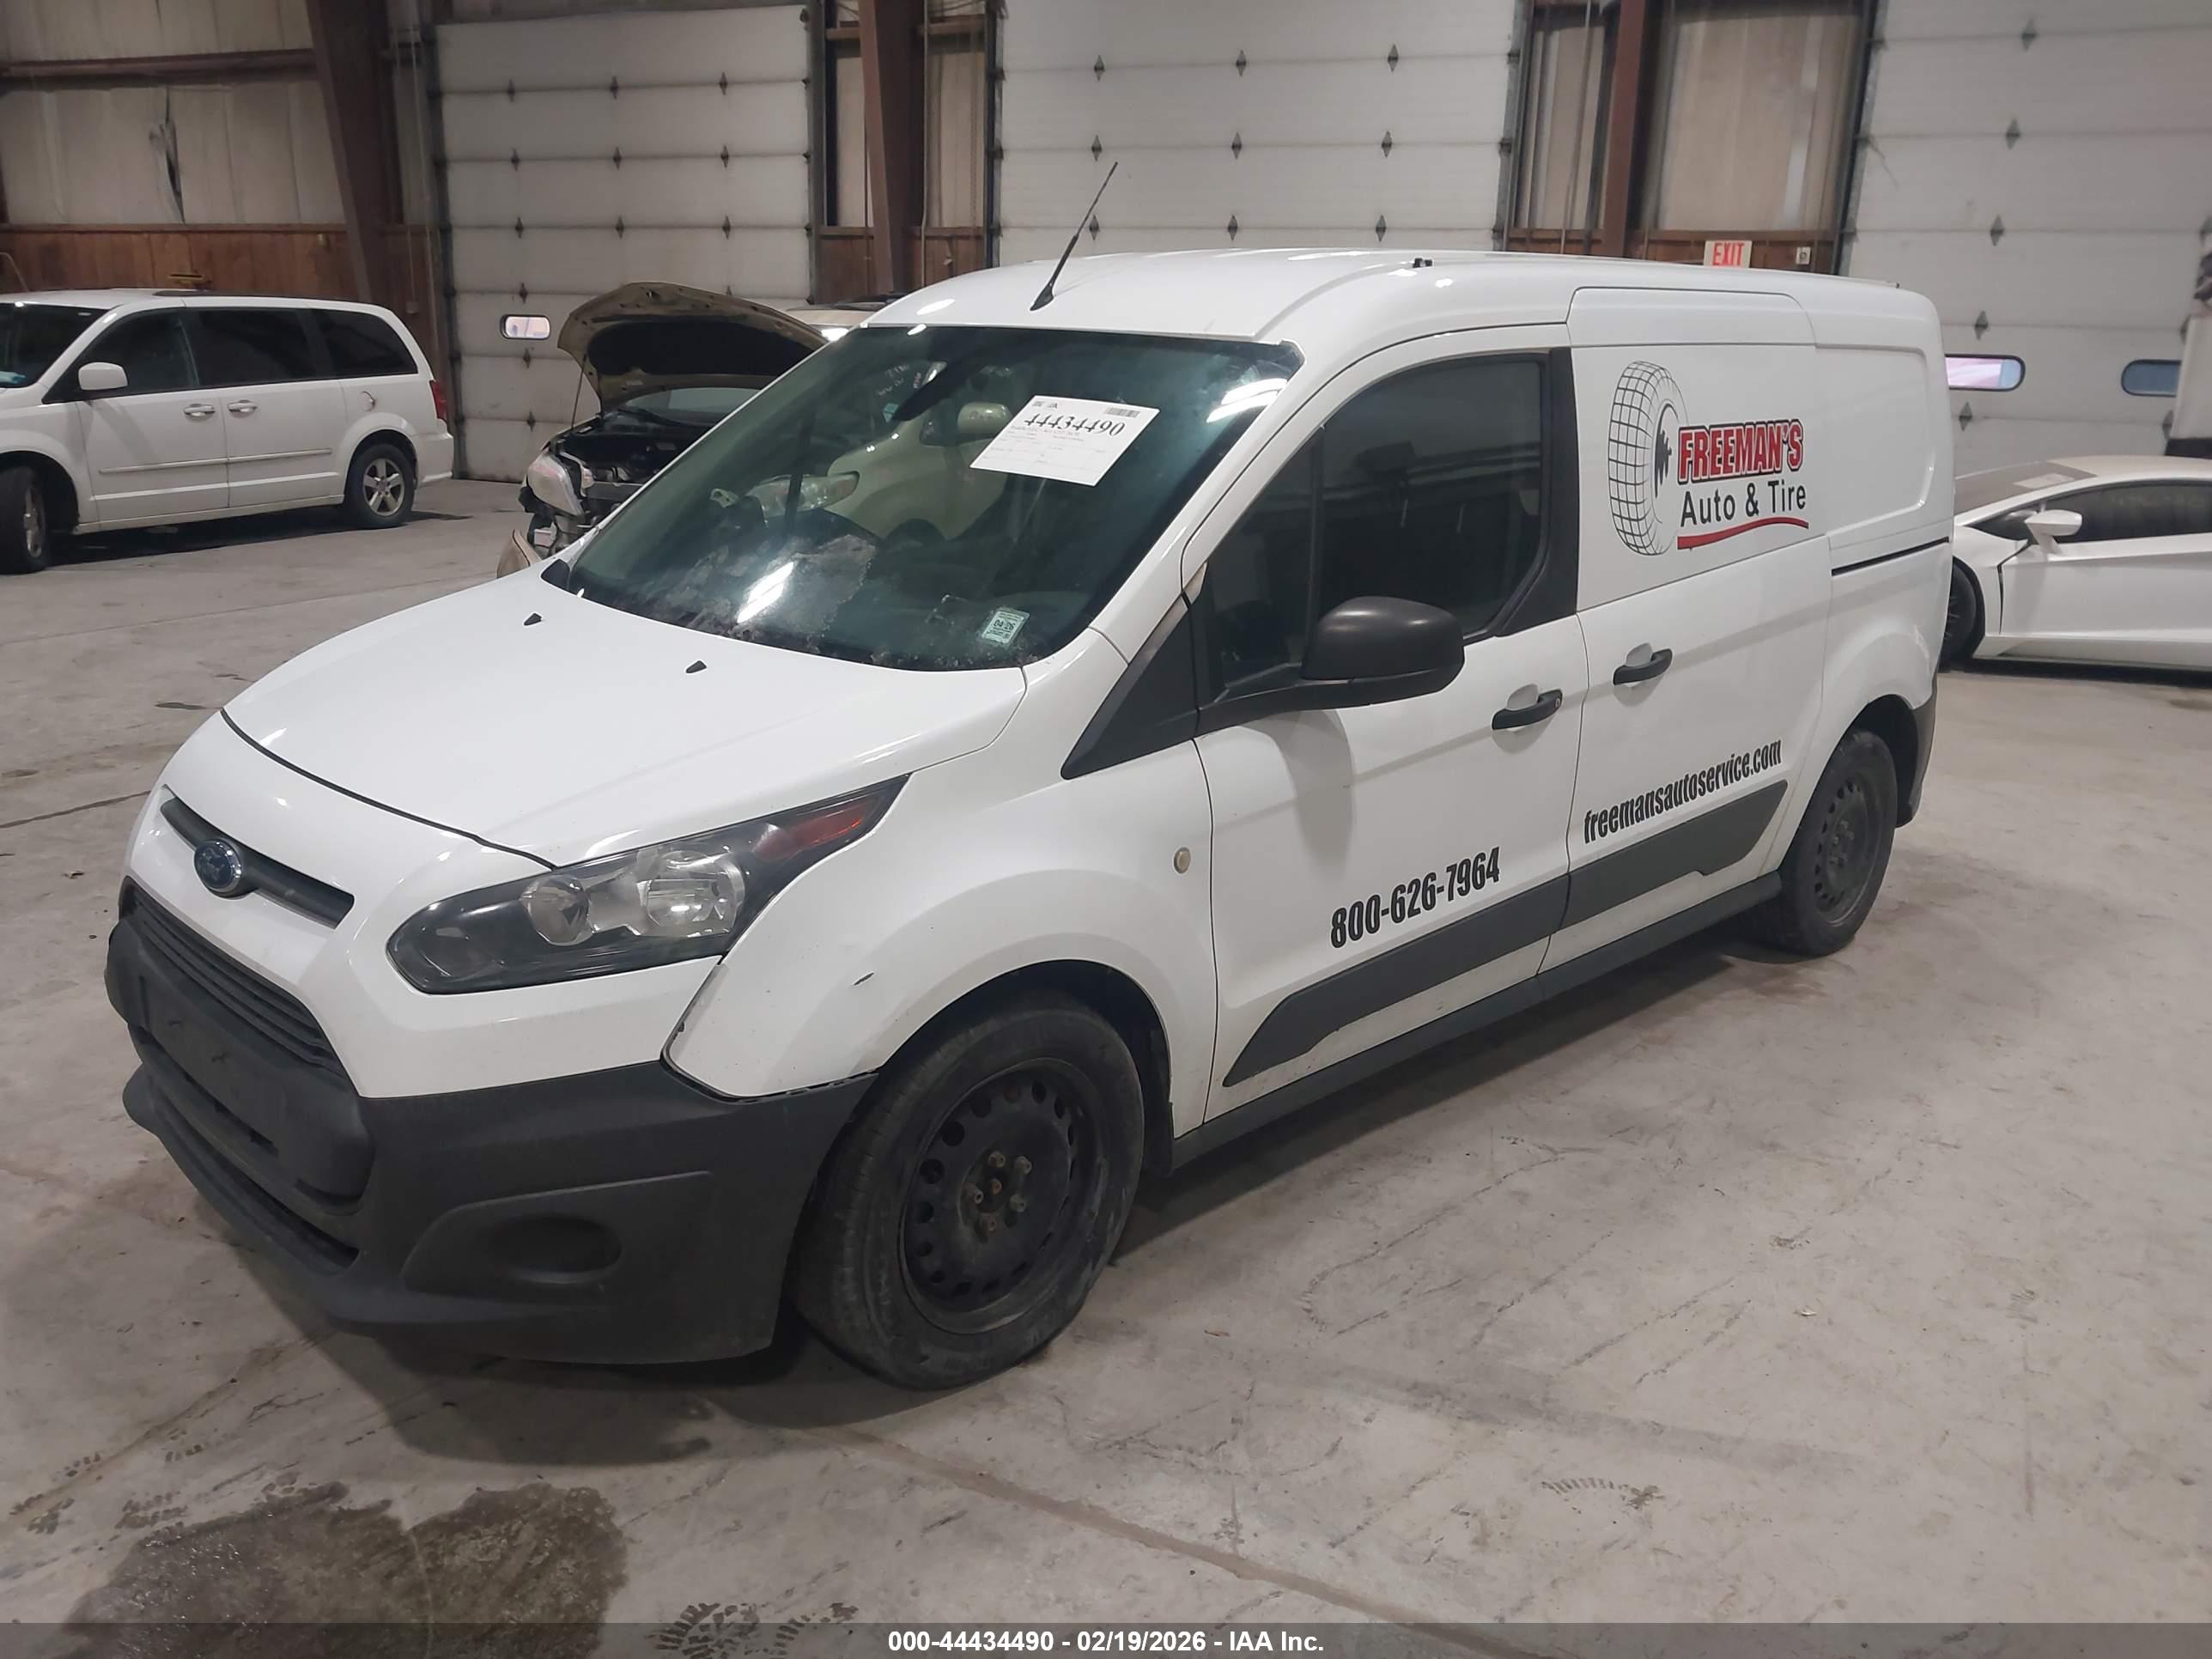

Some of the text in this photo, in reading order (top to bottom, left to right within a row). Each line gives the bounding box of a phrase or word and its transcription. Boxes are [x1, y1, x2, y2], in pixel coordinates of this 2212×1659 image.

[1711, 241, 1745, 266] EXIT
[1024, 412, 1126, 436] 44434490
[1677, 419, 1804, 484] FREEMAN'S
[1680, 480, 1807, 527] Auto & Tire
[1583, 739, 1782, 842] freemansautoservice.com
[1330, 847, 1501, 948] 800-626-7964
